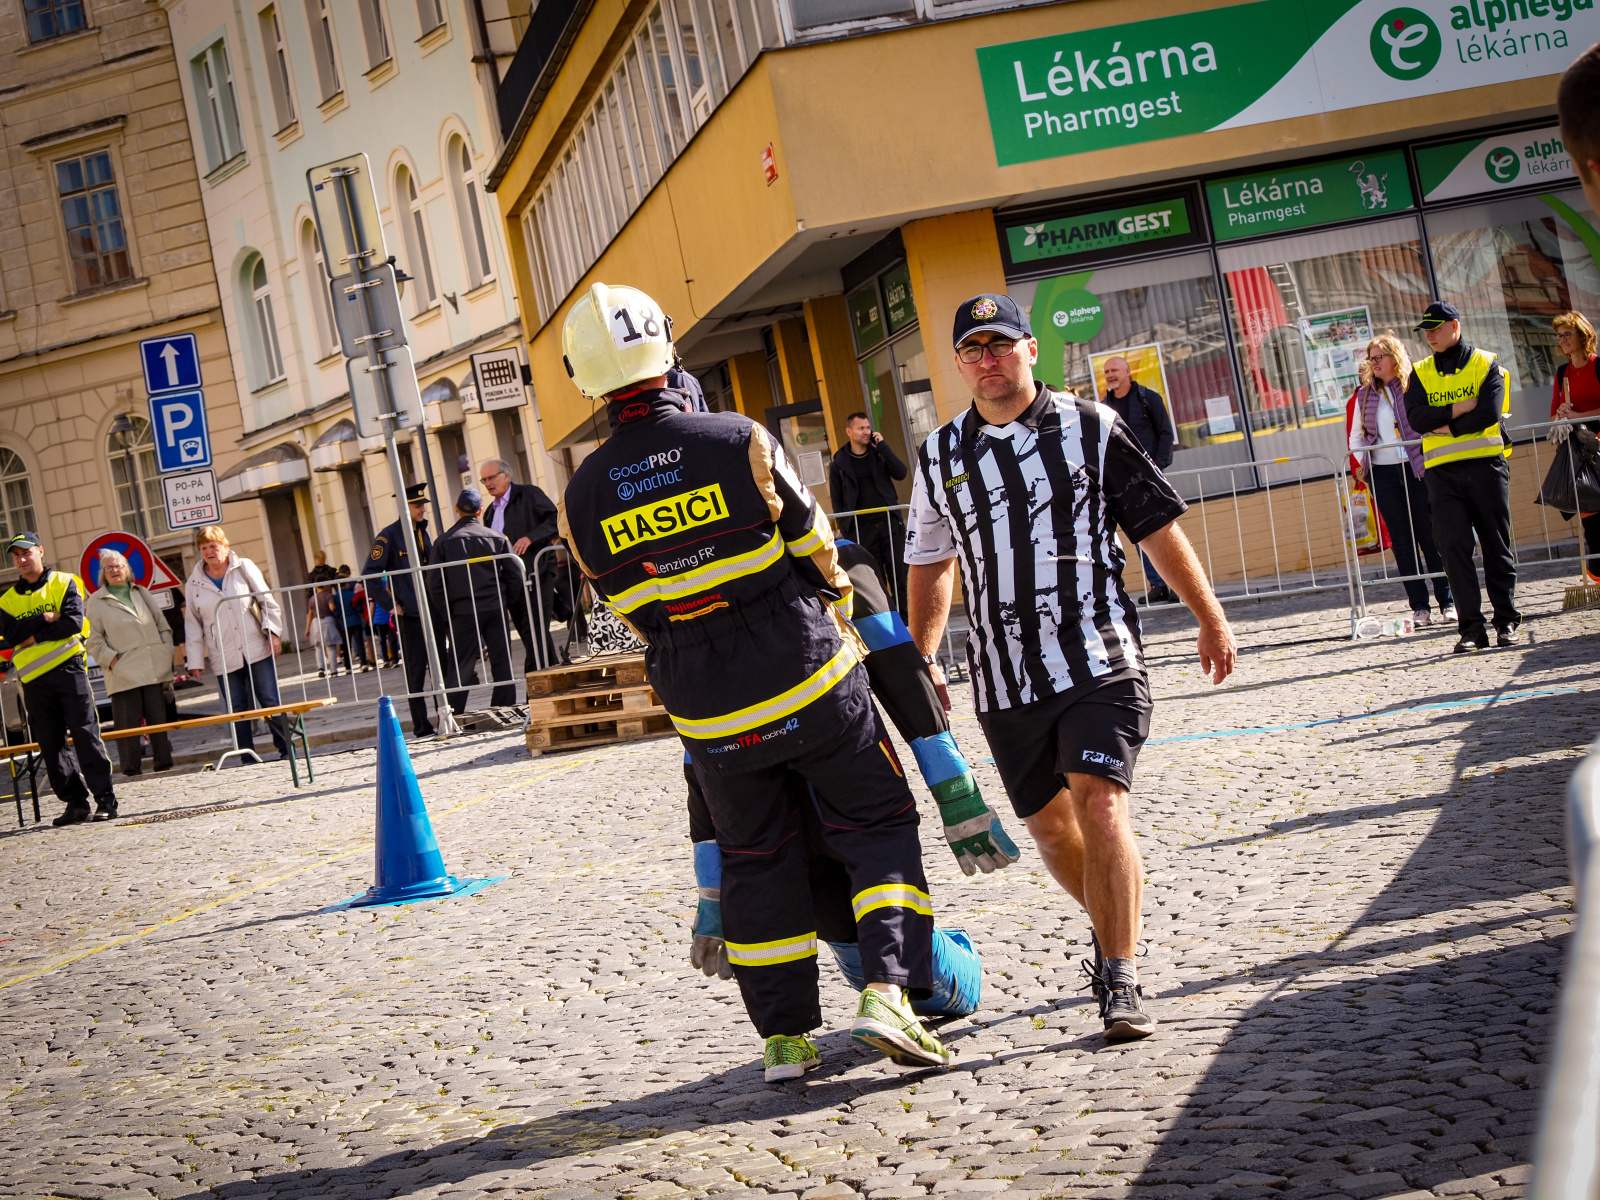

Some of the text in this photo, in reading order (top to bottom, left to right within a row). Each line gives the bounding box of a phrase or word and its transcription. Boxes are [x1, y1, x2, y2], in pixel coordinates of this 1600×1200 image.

[1456, 28, 1569, 64] lékárna
[1013, 41, 1218, 103] Lékárna
[1023, 91, 1182, 138] Pharmgest
[1223, 177, 1324, 209] Lékárna
[1036, 209, 1172, 249] PHARMGEST
[1228, 202, 1306, 226] Pharmgest
[1069, 305, 1101, 317] alphega
[161, 402, 194, 448] P
[190, 508, 207, 519] PB1
[195, 492, 211, 503] hod
[607, 490, 723, 549] HASIČI
[664, 592, 723, 614] Teijinconex
[736, 732, 763, 749] TFA
